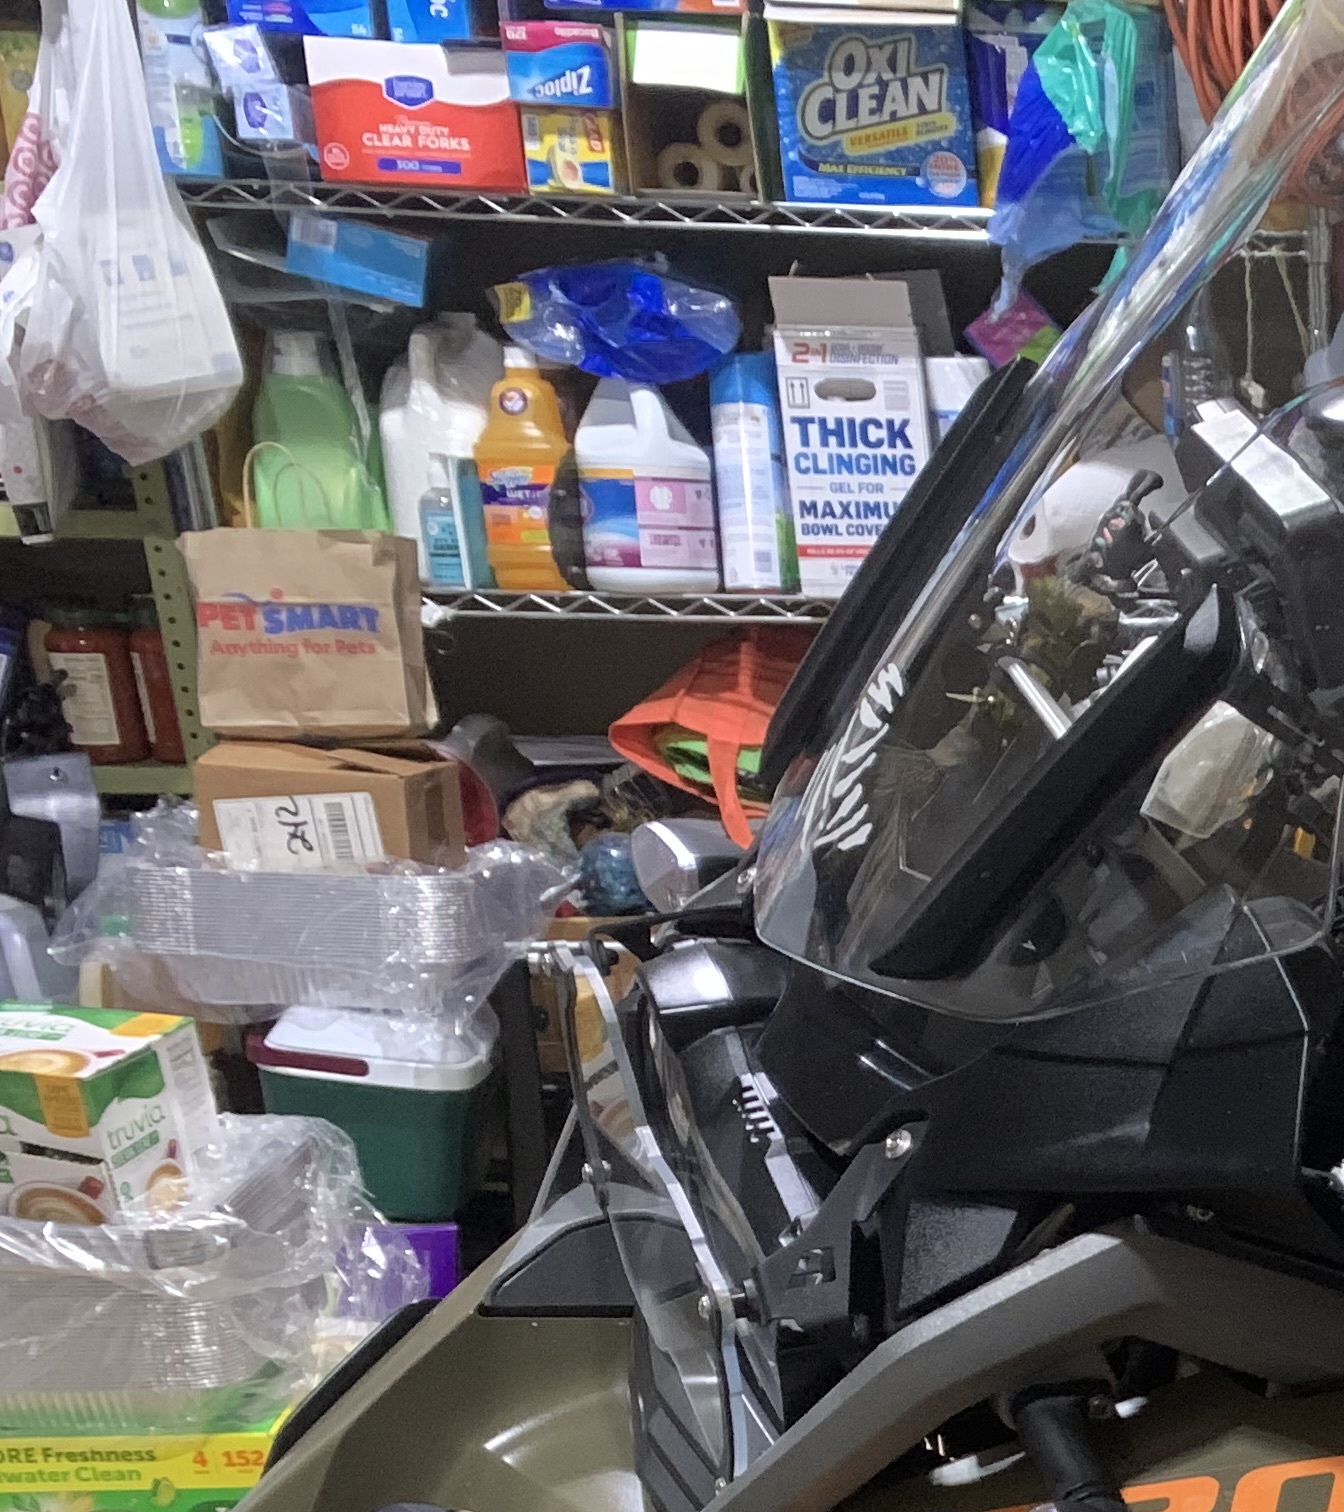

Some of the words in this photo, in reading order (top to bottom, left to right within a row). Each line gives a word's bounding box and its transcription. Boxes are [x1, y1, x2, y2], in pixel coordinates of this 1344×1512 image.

[829, 35, 912, 90] OXI
[535, 65, 593, 97] Ziploc
[803, 70, 943, 139] CLEAN
[379, 124, 415, 135] HEAVY
[419, 125, 449, 136] DUTY
[850, 126, 909, 147] VERSATILE
[362, 132, 413, 148] CLEAR
[418, 135, 471, 151] FORKS
[819, 162, 843, 173] MAX
[847, 163, 907, 175] EFFICIENCY
[790, 416, 913, 449] THICK
[793, 452, 916, 476] CLINGING
[829, 482, 855, 494] GEL
[858, 482, 884, 494] FOR
[799, 500, 899, 519] MAXIMU
[801, 523, 843, 536] BOWL
[846, 523, 884, 536] COVE
[210, 639, 298, 658] Anything
[303, 638, 331, 654] for
[335, 639, 376, 655] Pets
[107, 1103, 166, 1150] truvia
[42, 1447, 157, 1464] Freshness
[193, 1451, 207, 1467] 4
[222, 1450, 264, 1467] 152
[0, 1468, 70, 1483] water
[74, 1466, 142, 1482] Clean
